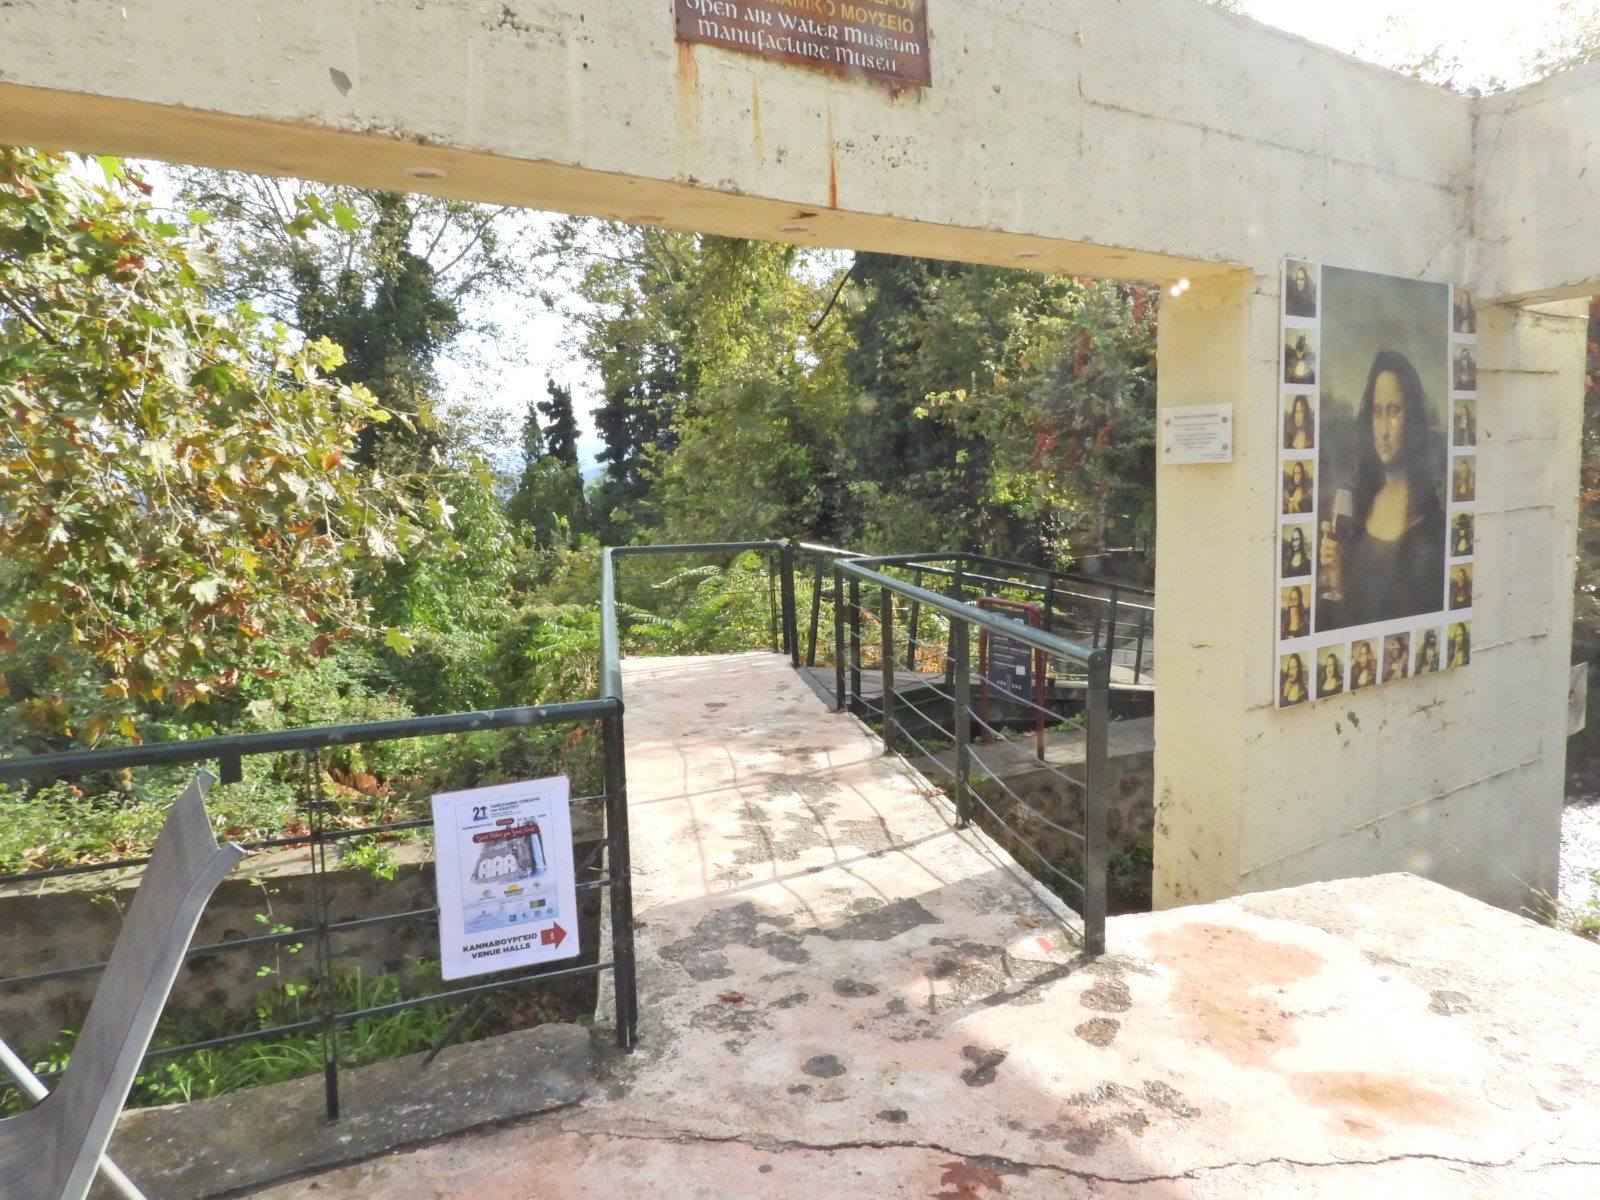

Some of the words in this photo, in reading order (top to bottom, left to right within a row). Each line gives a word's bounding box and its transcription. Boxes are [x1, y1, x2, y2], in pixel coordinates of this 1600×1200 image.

[840, 3, 914, 34] ΜΟΥΣΕΙΟ
[698, 18, 830, 60] Manufacture
[462, 933, 538, 953] ΚΑΝΝΑΒΟΥΡΓΕΙΟ
[471, 948, 501, 959] VENUE
[502, 942, 531, 954] HALLS
